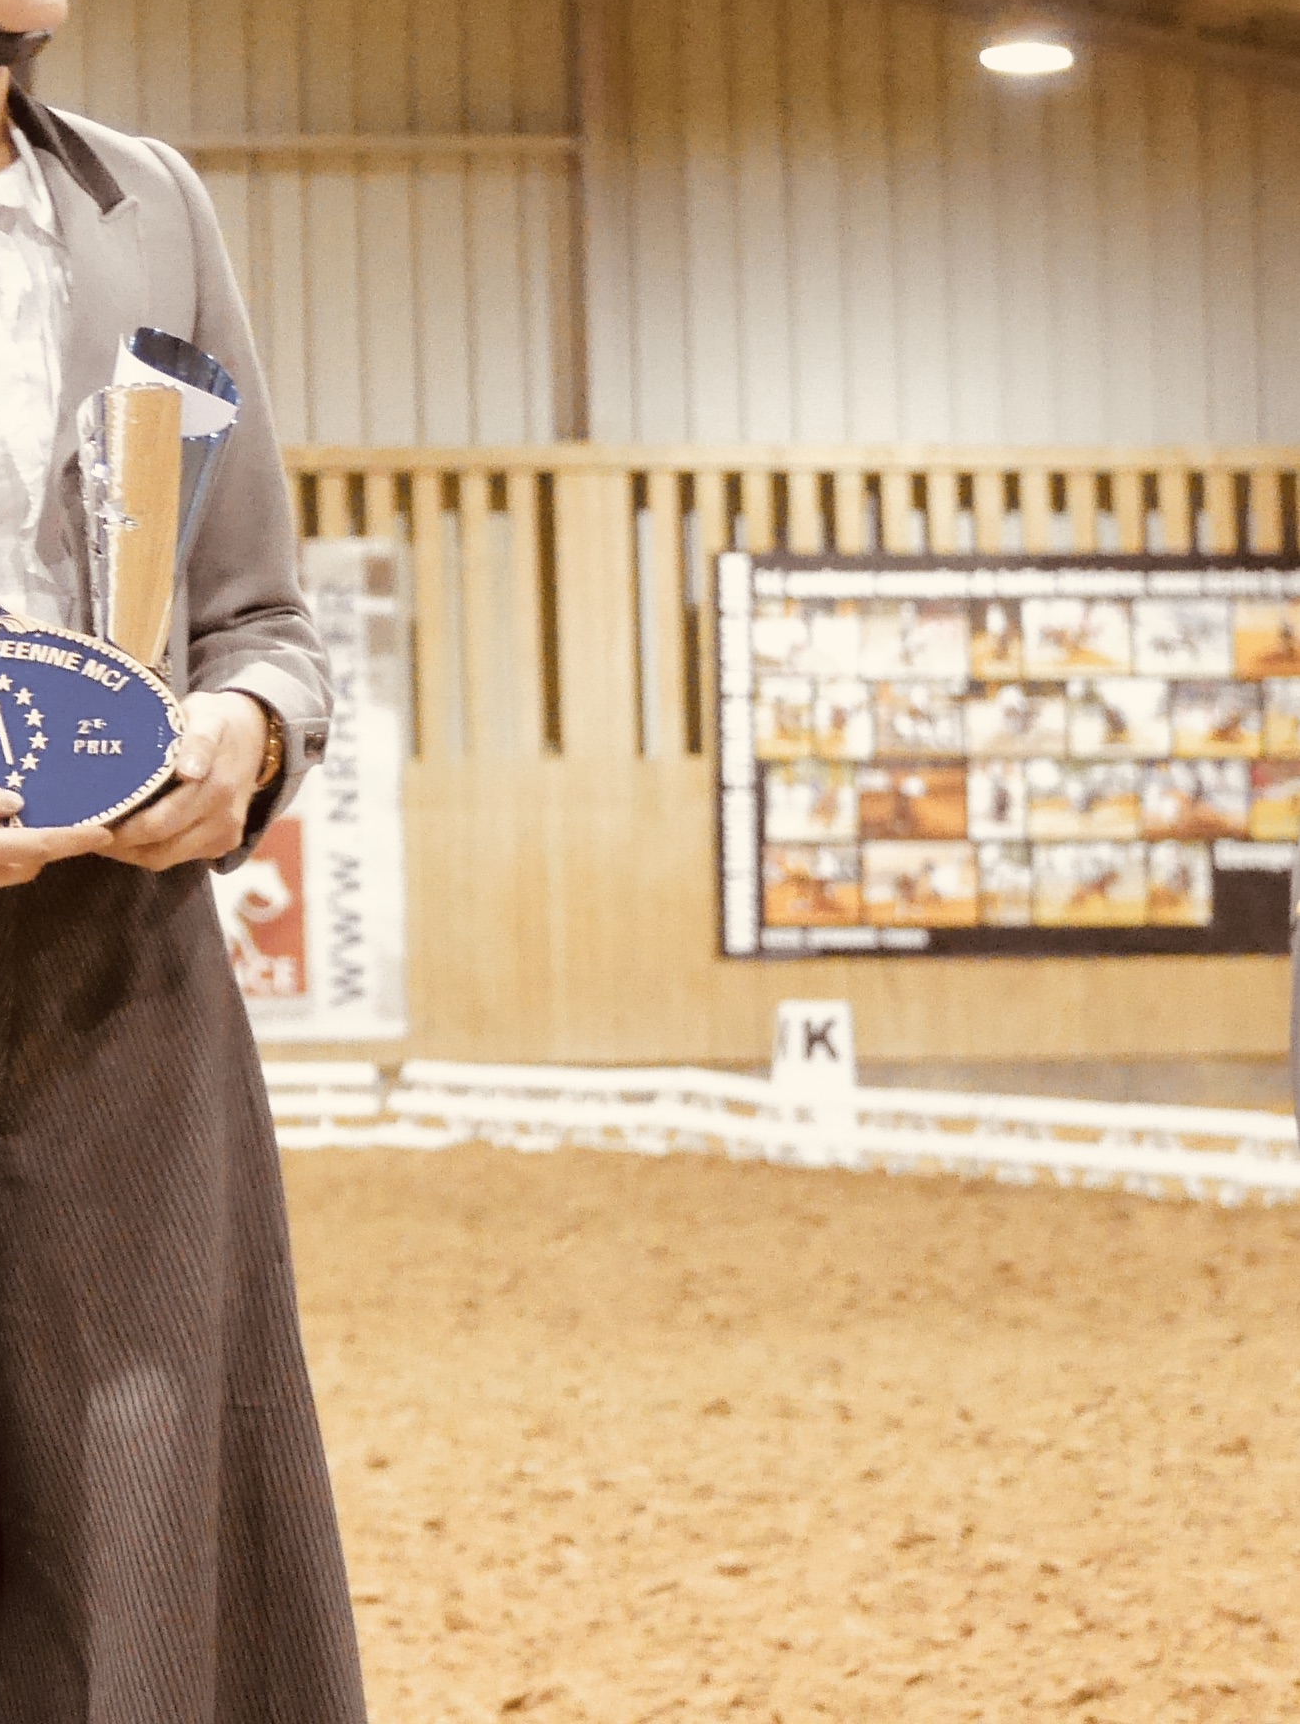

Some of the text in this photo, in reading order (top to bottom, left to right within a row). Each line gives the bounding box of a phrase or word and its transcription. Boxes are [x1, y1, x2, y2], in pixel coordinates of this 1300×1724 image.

[80, 658, 130, 692] MCI
[73, 739, 123, 755] PRIX
[801, 1016, 839, 1063] K
